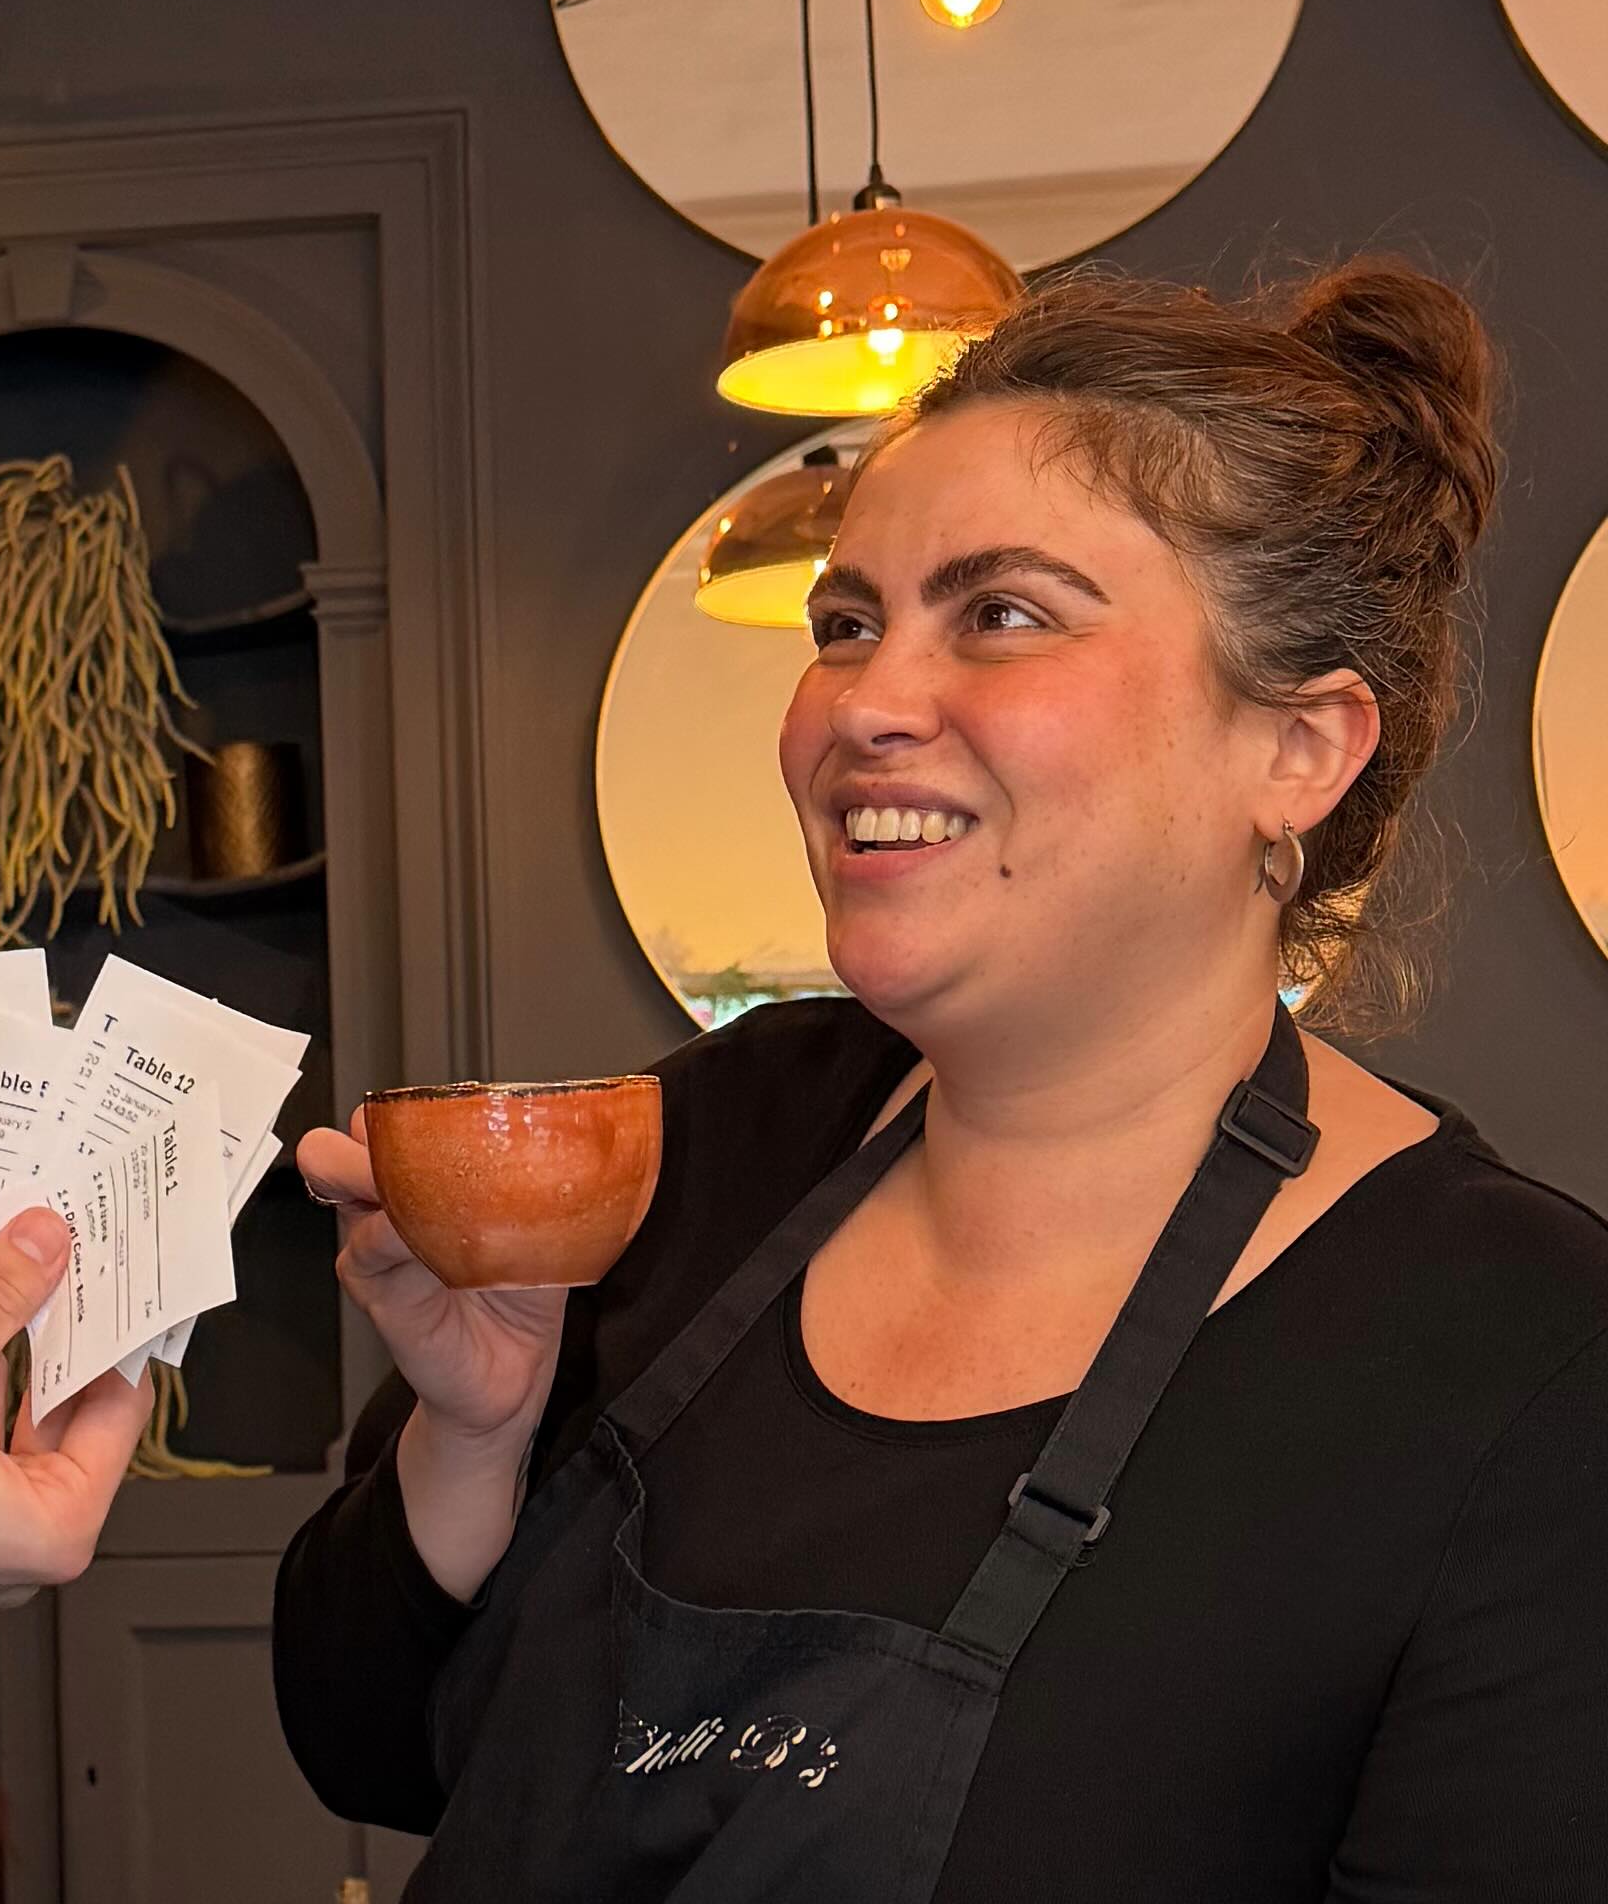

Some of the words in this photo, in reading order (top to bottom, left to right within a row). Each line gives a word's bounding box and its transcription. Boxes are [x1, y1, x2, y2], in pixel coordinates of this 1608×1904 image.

[126, 1045, 173, 1085] Table
[174, 1074, 195, 1094] 12
[163, 1120, 178, 1178] Table
[166, 1180, 178, 1196] 1
